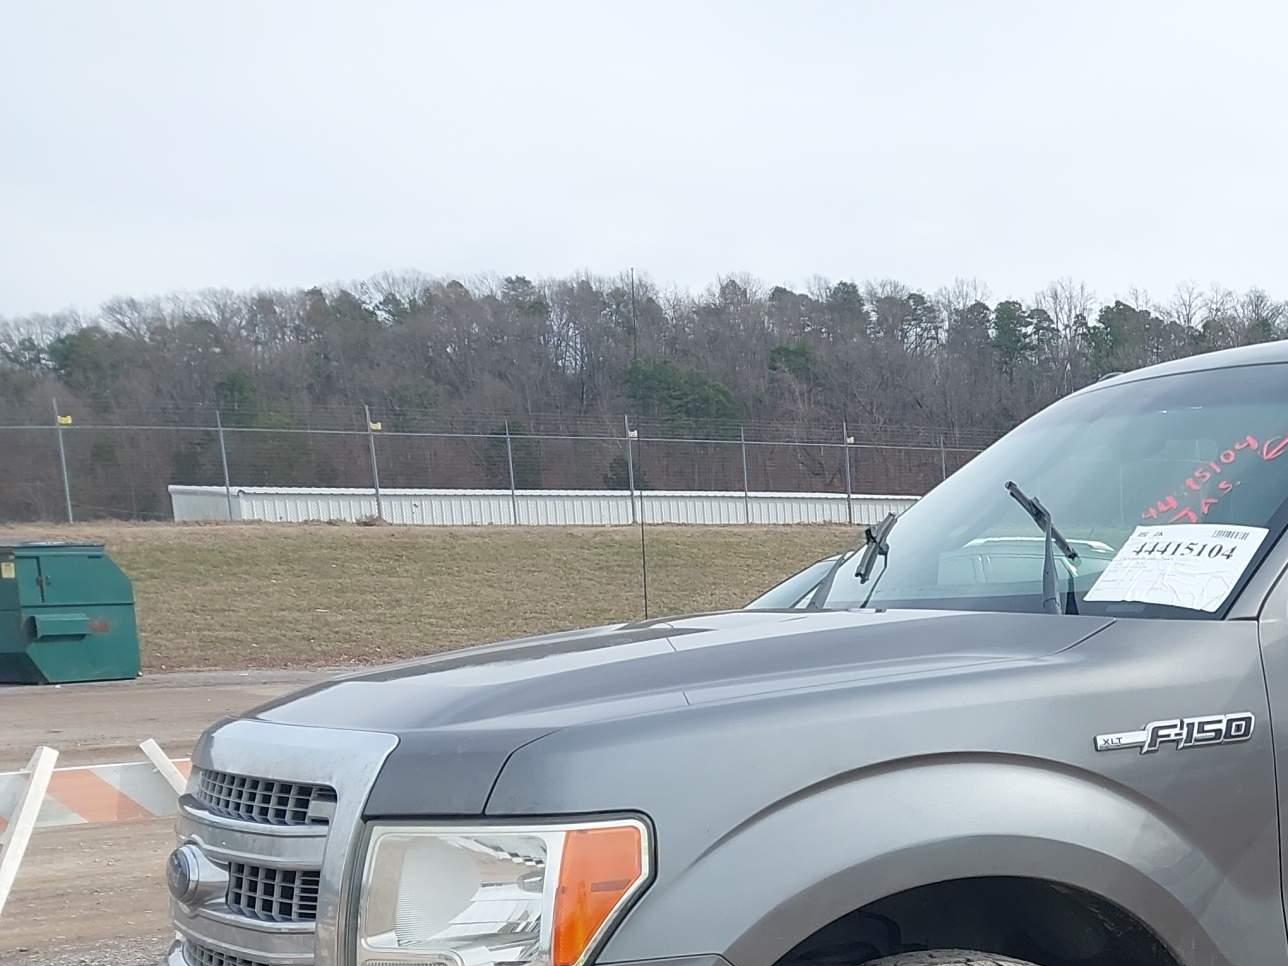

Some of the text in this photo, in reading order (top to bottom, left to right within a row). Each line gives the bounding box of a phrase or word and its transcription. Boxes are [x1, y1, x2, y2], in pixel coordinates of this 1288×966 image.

[1133, 541, 1237, 560] 44415104
[1102, 711, 1256, 755] XLT F-150
